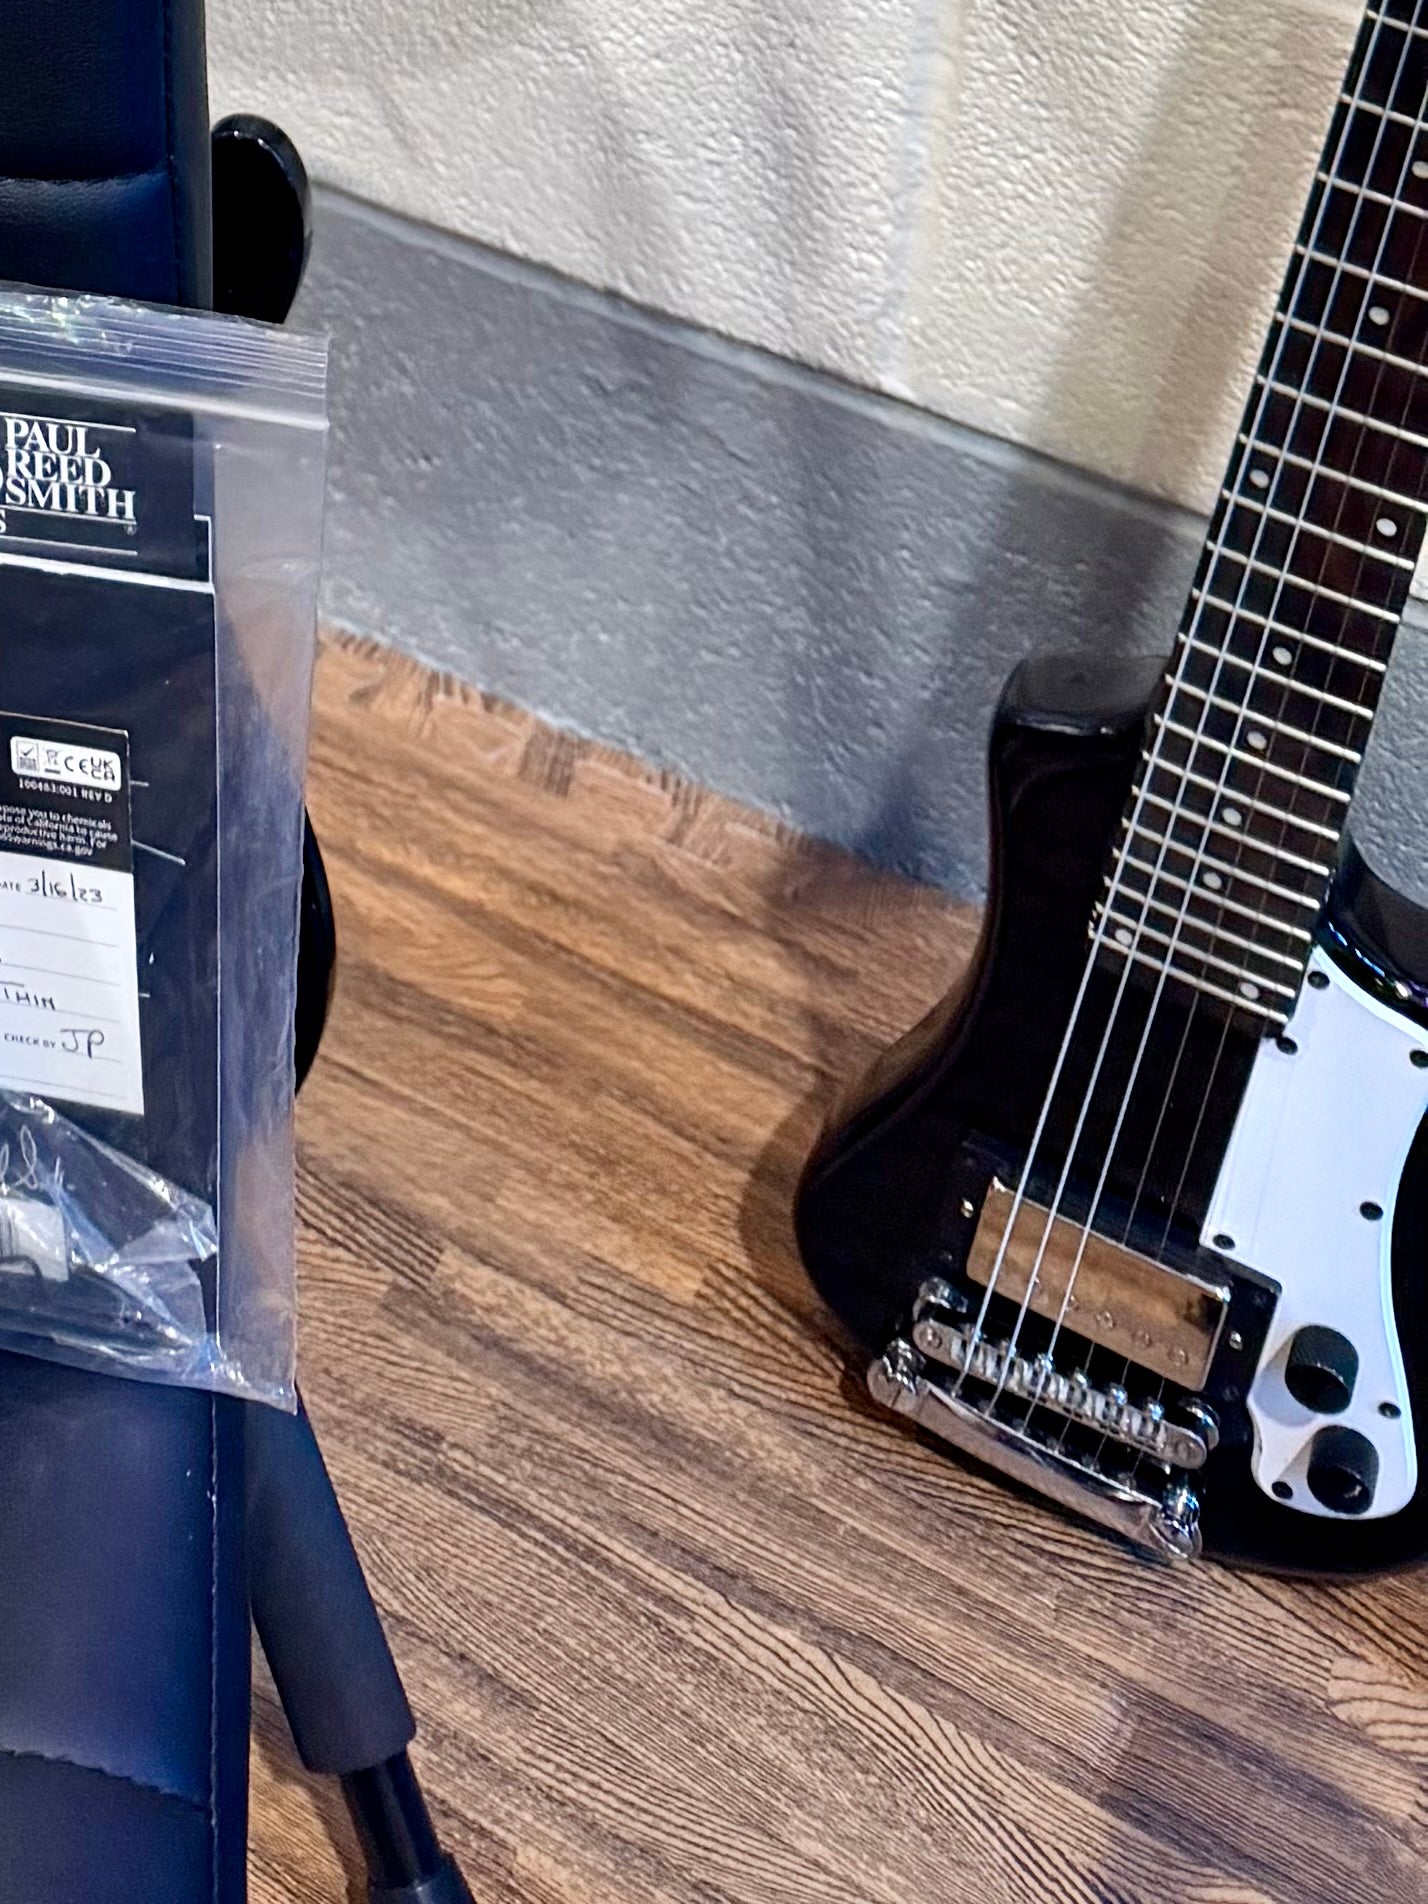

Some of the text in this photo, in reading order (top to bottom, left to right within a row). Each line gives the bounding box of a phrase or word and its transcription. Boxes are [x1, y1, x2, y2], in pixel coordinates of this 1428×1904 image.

[5, 416, 101, 459] PAUL
[5, 447, 113, 488] REED
[5, 476, 137, 521] SMITH
[27, 869, 104, 904] 3/16/23
[4, 1032, 40, 1046] CHECK
[42, 1039, 56, 1050] BY
